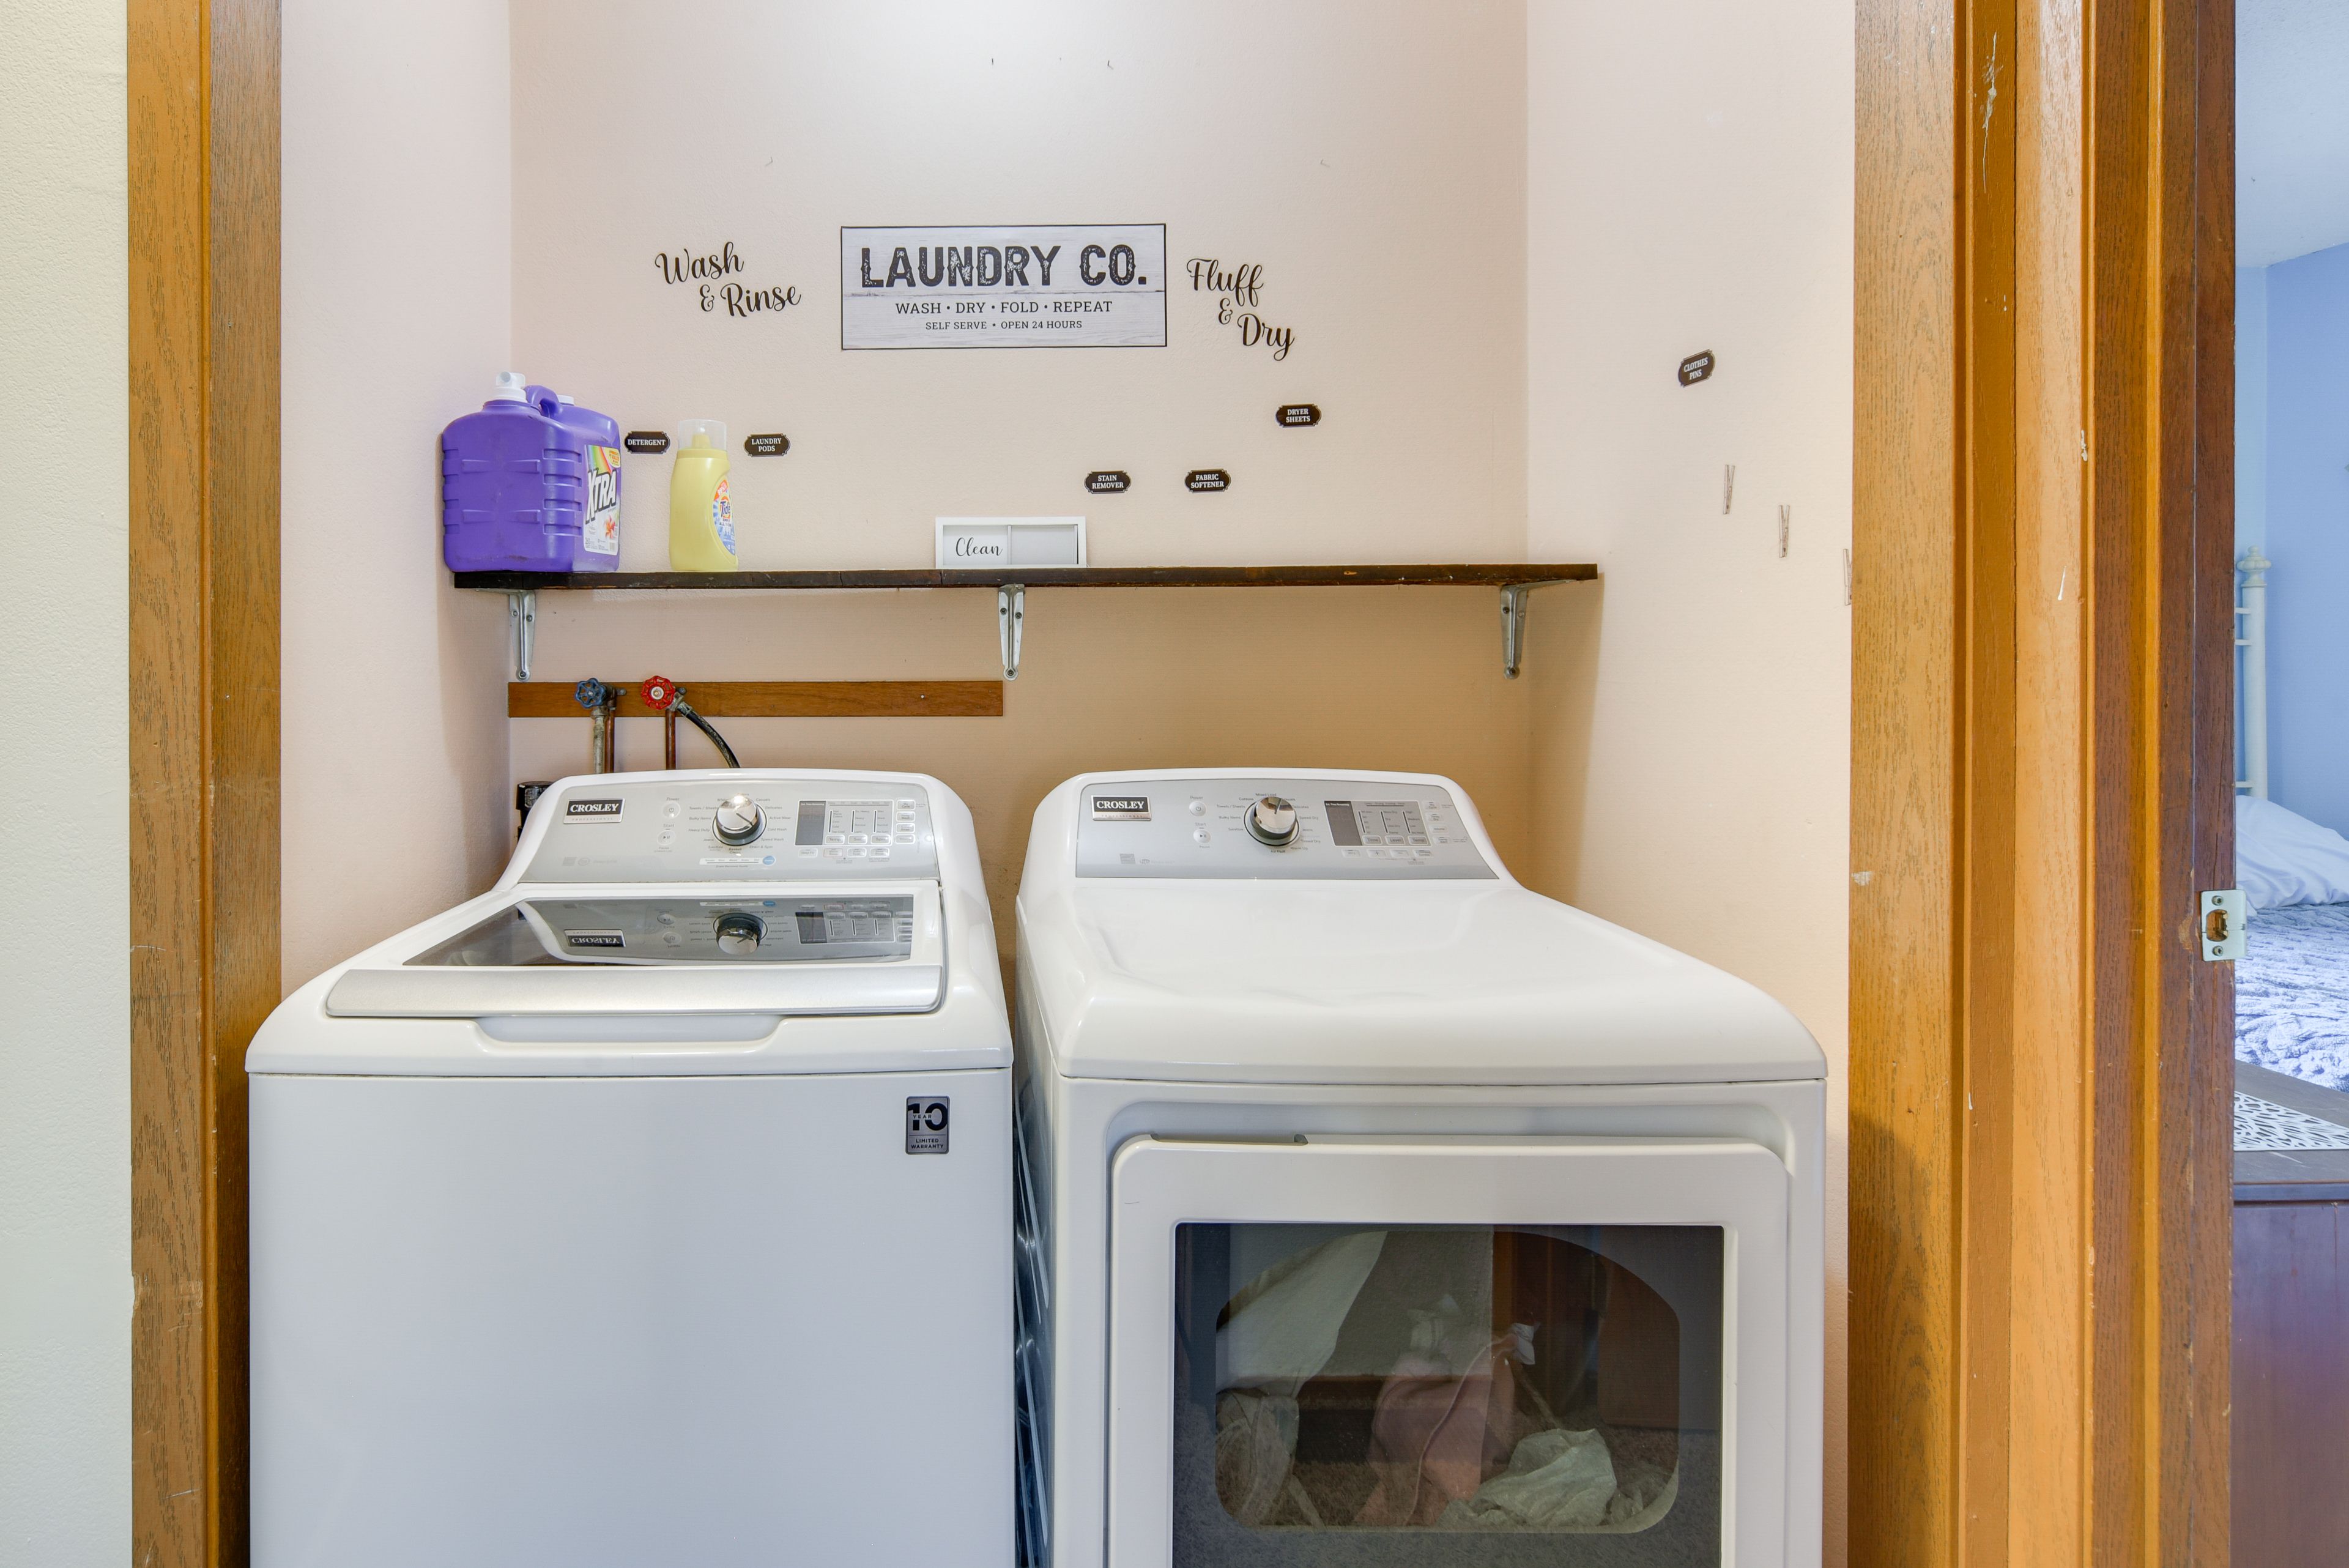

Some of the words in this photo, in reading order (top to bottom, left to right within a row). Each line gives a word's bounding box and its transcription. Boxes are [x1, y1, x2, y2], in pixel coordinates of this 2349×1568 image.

[655, 241, 744, 284] Wash
[861, 246, 1061, 288] LAUNDRY
[1079, 245, 1147, 286] CO.
[1187, 258, 1264, 307] Fluff
[699, 284, 714, 312] &
[720, 283, 801, 317] Rinse
[896, 303, 941, 314] WASH
[956, 302, 986, 313] DRY
[1001, 302, 1039, 313] FOLD
[1053, 301, 1113, 313] REPEAT
[1218, 298, 1233, 324] &
[1047, 321, 1082, 329] HOURS
[1237, 313, 1295, 361] Dry
[1684, 357, 1708, 372] CLOTHES
[1690, 369, 1702, 379] PINS
[586, 469, 617, 524] XTRA
[720, 501, 730, 517] Tide
[956, 537, 1003, 557] Clean
[570, 803, 619, 812] CROSLEY
[1096, 801, 1144, 809] CROSLEY
[908, 1102, 948, 1131] 10
